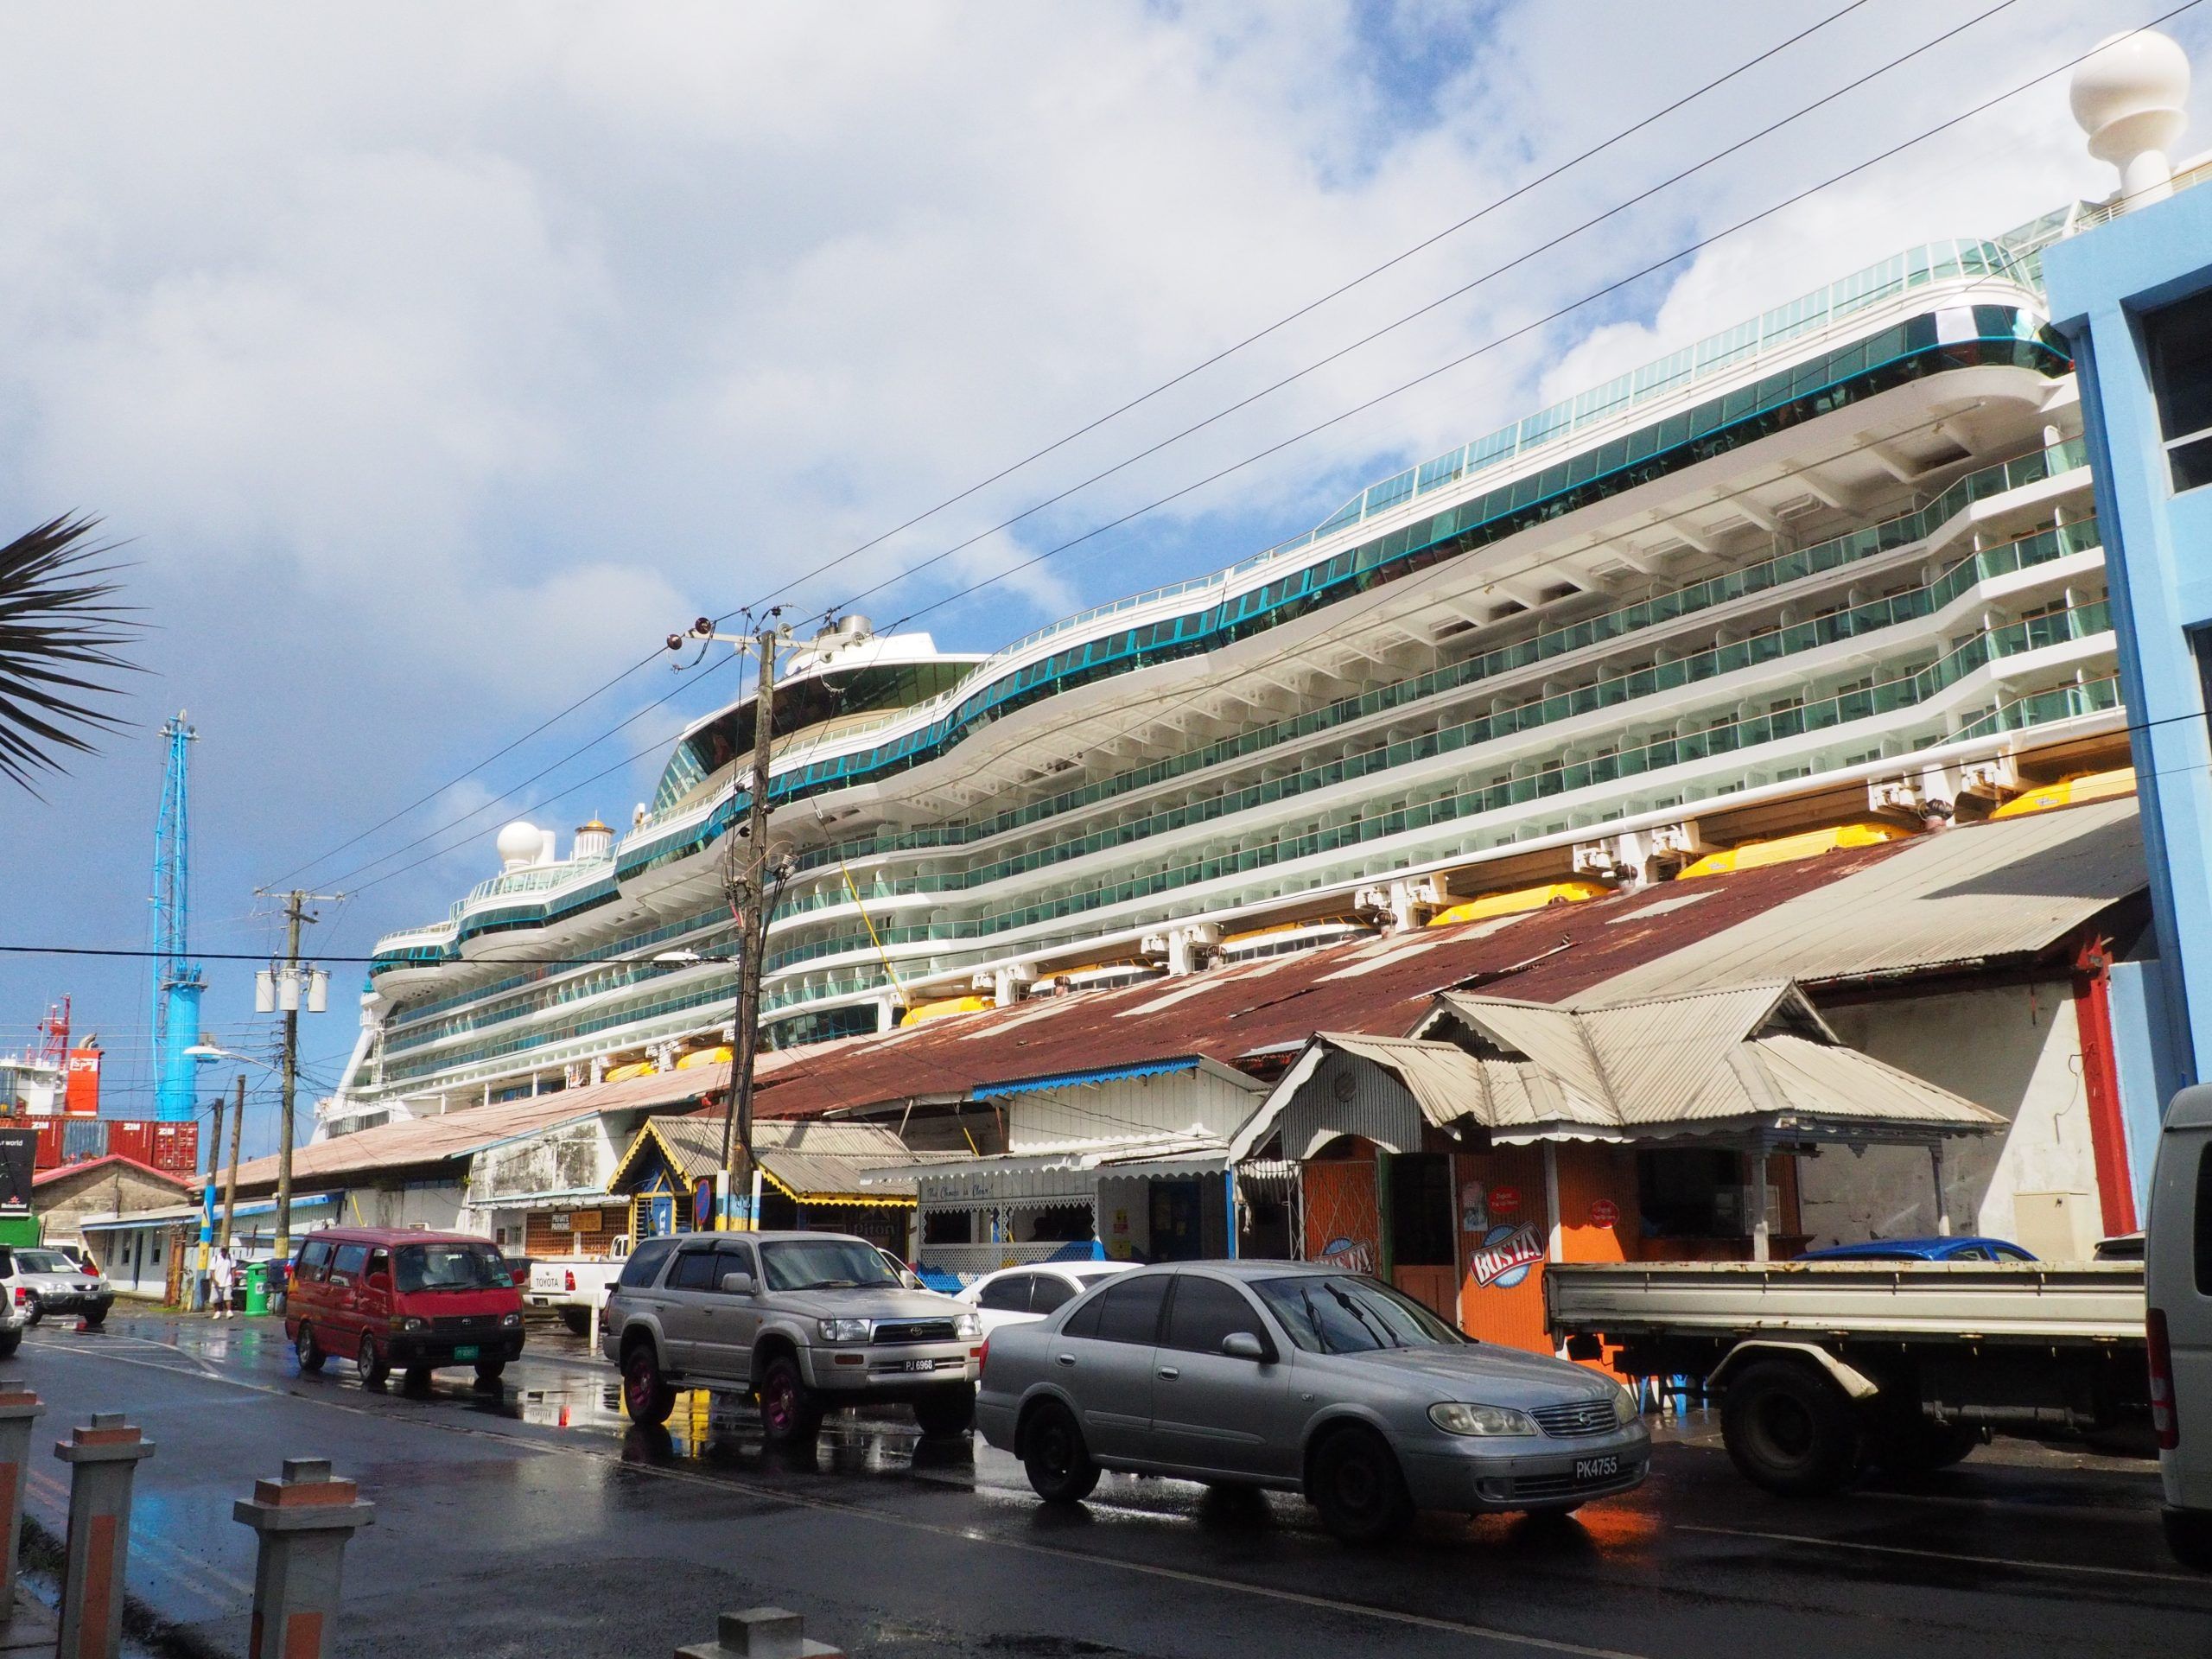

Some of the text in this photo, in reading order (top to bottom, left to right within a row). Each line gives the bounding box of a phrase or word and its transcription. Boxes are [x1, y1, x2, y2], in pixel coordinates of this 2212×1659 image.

[553, 1214, 569, 1223] PRIVATE
[551, 1223, 570, 1231] PARKING
[1474, 1230, 1542, 1284] BUSTA
[536, 1278, 559, 1287] TOYOTA
[906, 1359, 933, 1371] PJ 6968
[1576, 1457, 1618, 1478] PK4755
